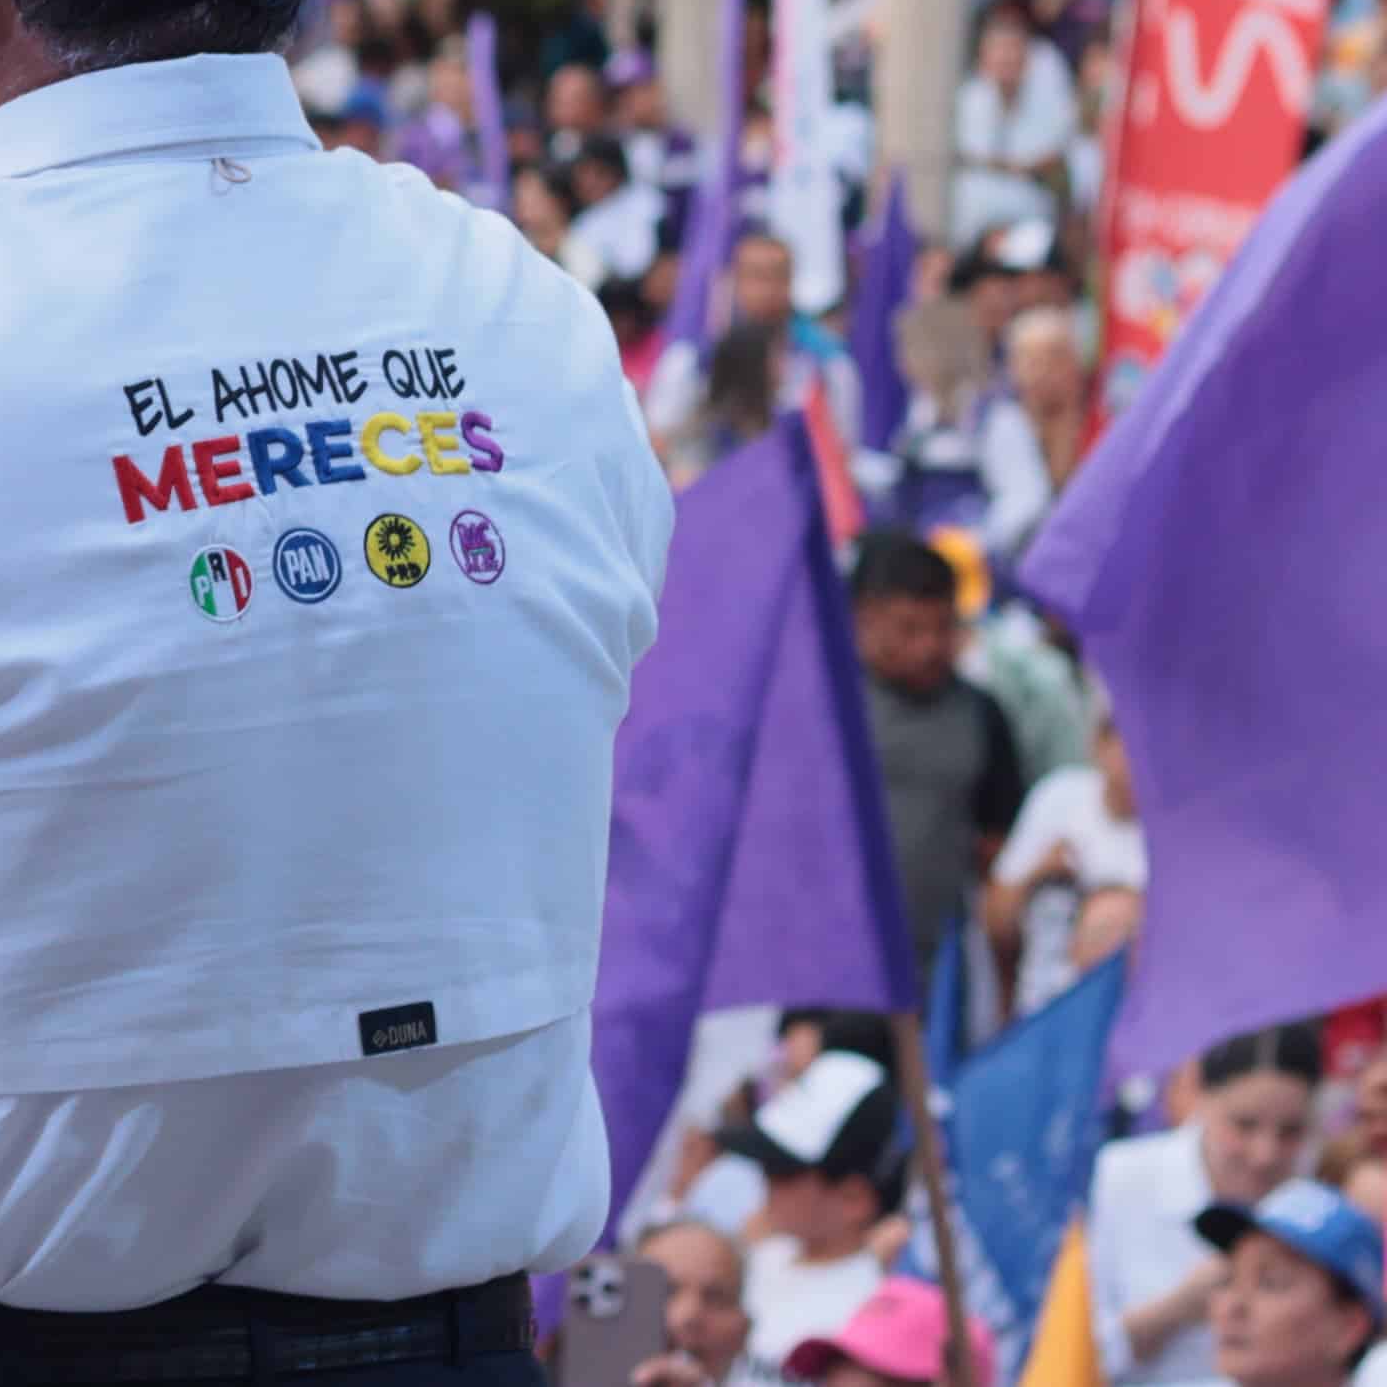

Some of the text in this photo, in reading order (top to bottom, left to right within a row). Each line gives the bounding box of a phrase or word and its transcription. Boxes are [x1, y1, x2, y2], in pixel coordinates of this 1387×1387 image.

[123, 347, 466, 436] EL AHOME QUE
[112, 410, 505, 524] MERECES
[282, 543, 330, 587] PAN
